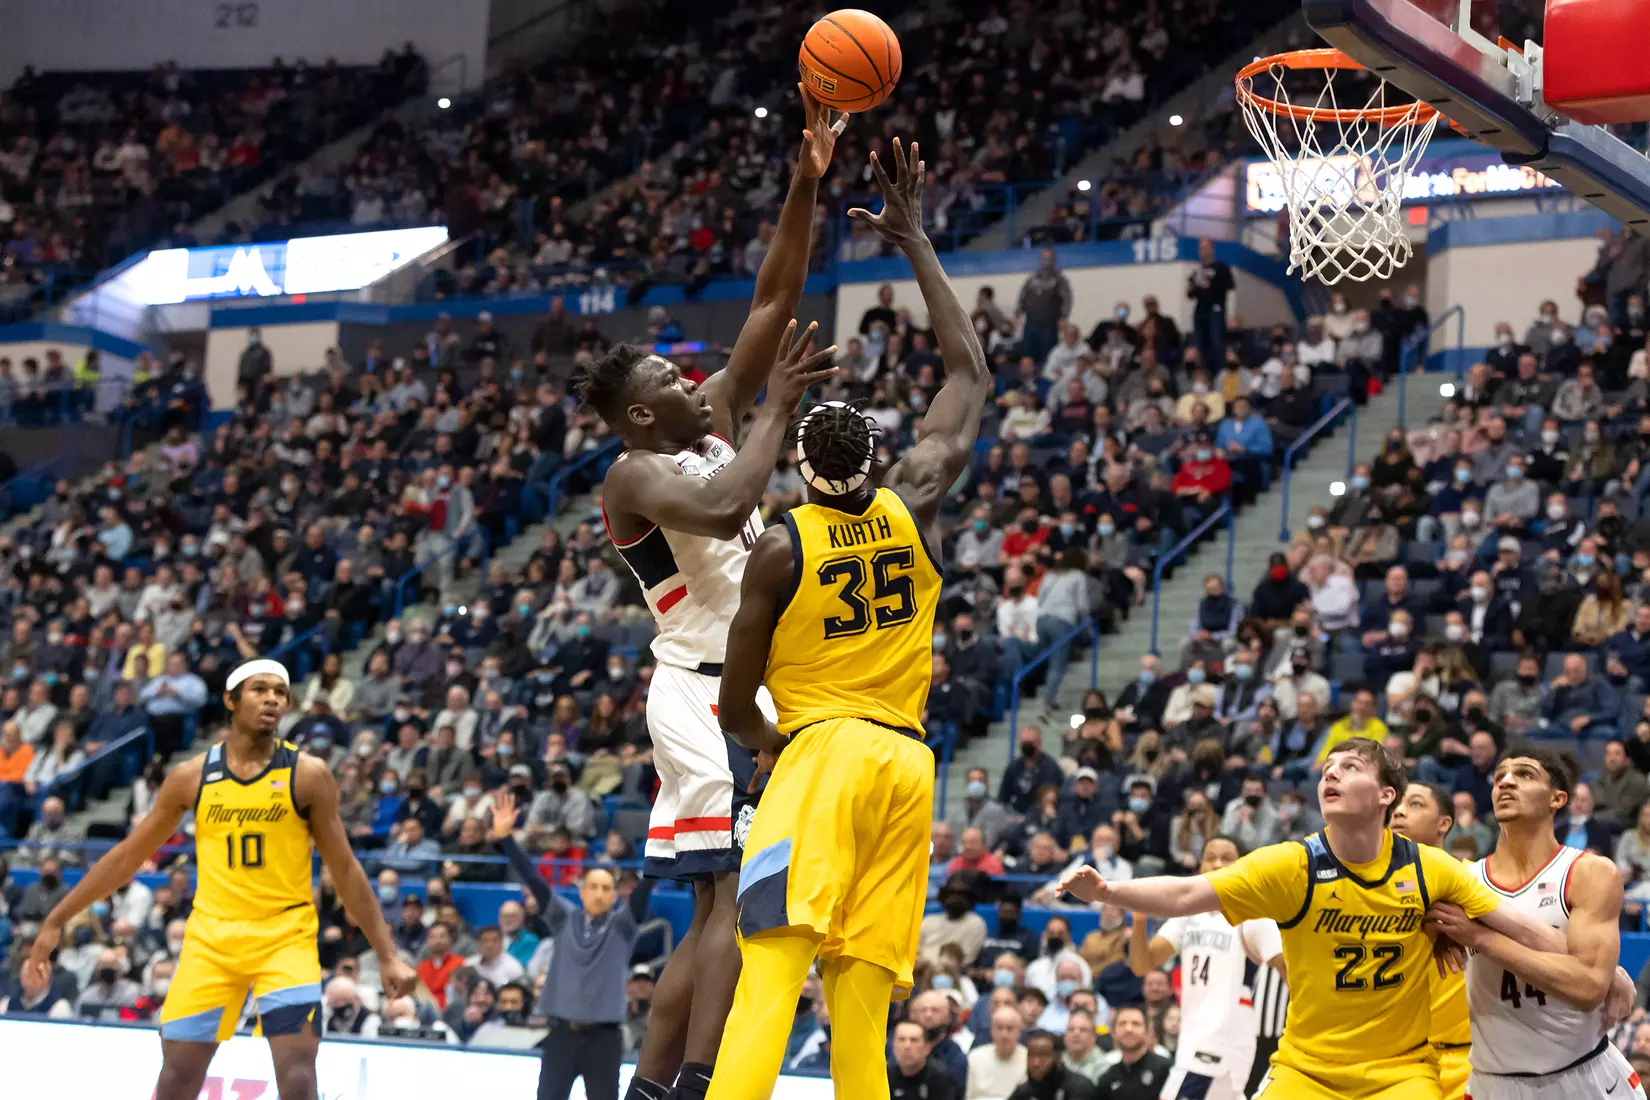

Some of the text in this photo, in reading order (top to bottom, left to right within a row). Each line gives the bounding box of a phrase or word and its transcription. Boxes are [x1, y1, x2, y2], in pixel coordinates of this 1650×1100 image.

[215, 3, 259, 28] 212
[1132, 237, 1177, 262] 115
[579, 285, 615, 315] 114
[827, 514, 892, 549] KUATH
[816, 545, 919, 640] 35
[206, 803, 288, 827] Marquette
[226, 832, 265, 870] 10
[1314, 907, 1424, 940] Marquette
[1190, 955, 1211, 986] 24
[1333, 943, 1406, 991] 22
[1501, 968, 1547, 1009] 44
